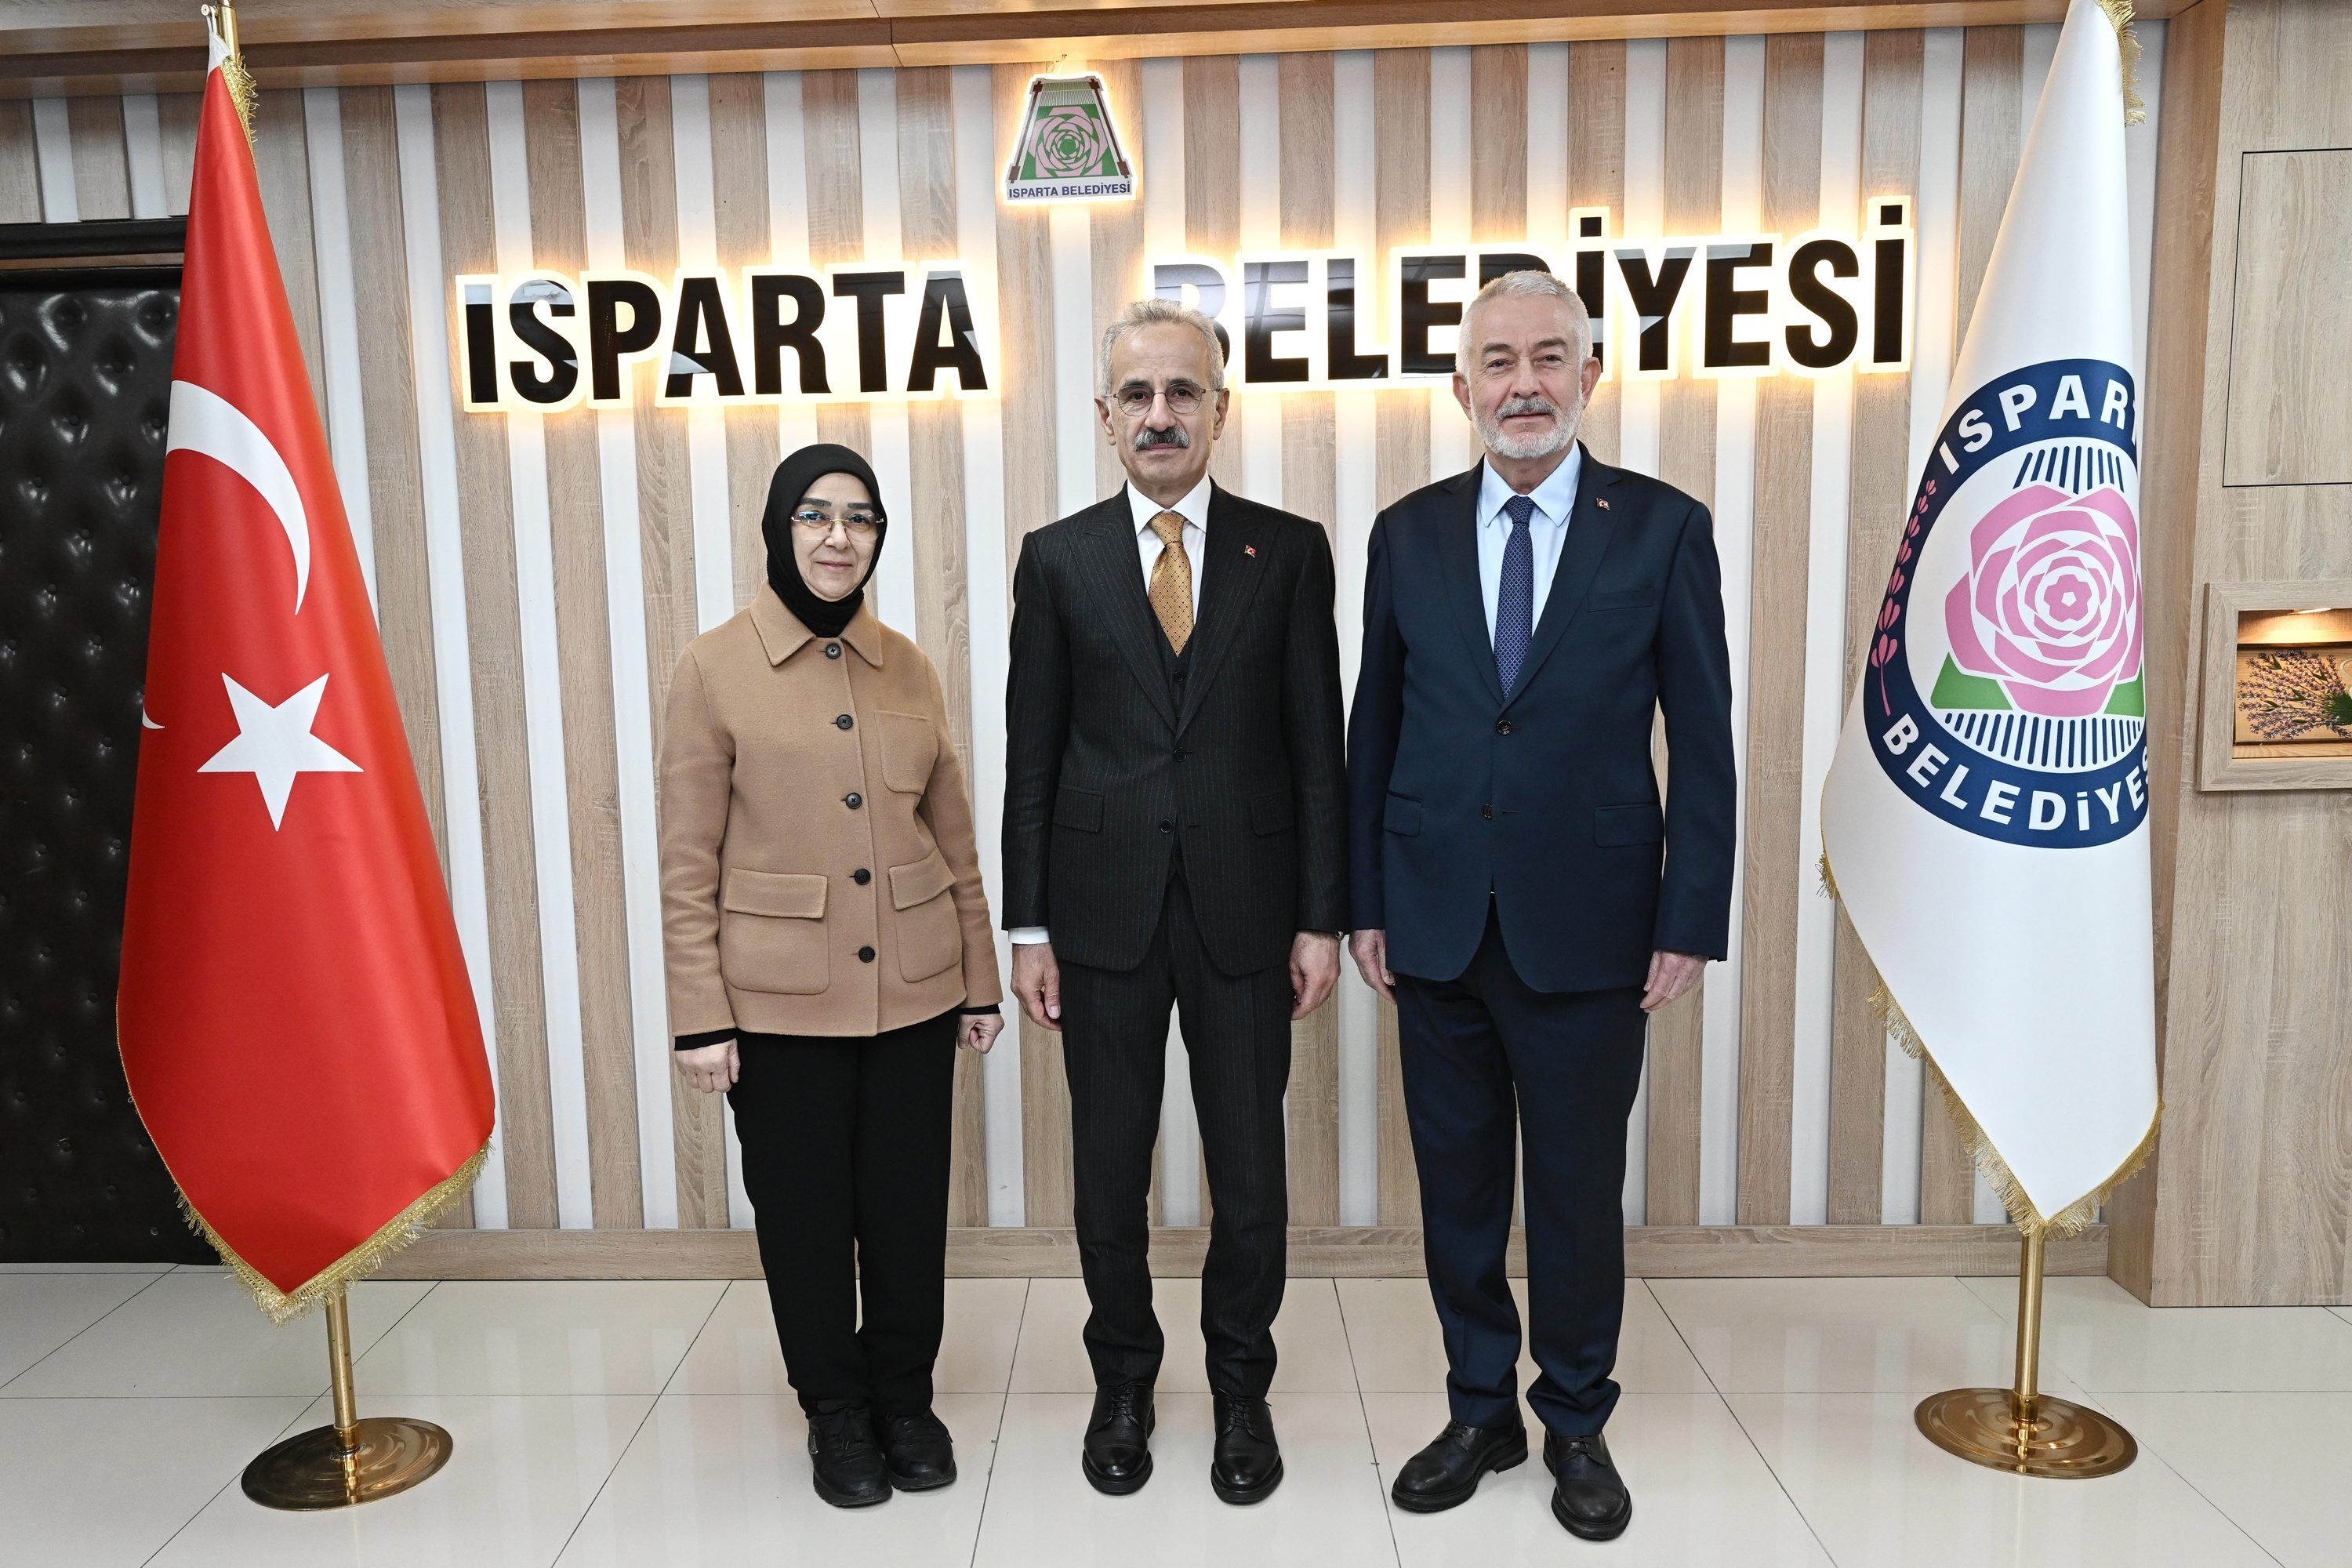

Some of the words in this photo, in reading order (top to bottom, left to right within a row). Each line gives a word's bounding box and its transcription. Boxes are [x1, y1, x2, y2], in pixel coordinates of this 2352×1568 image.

[1009, 187, 1058, 198] ISPARTA
[1062, 181, 1131, 196] BELEDİYESİ
[464, 270, 989, 404] ISPARTA
[1153, 205, 1905, 383] ELEİYESİ
[1939, 375, 2136, 475] ISPAR
